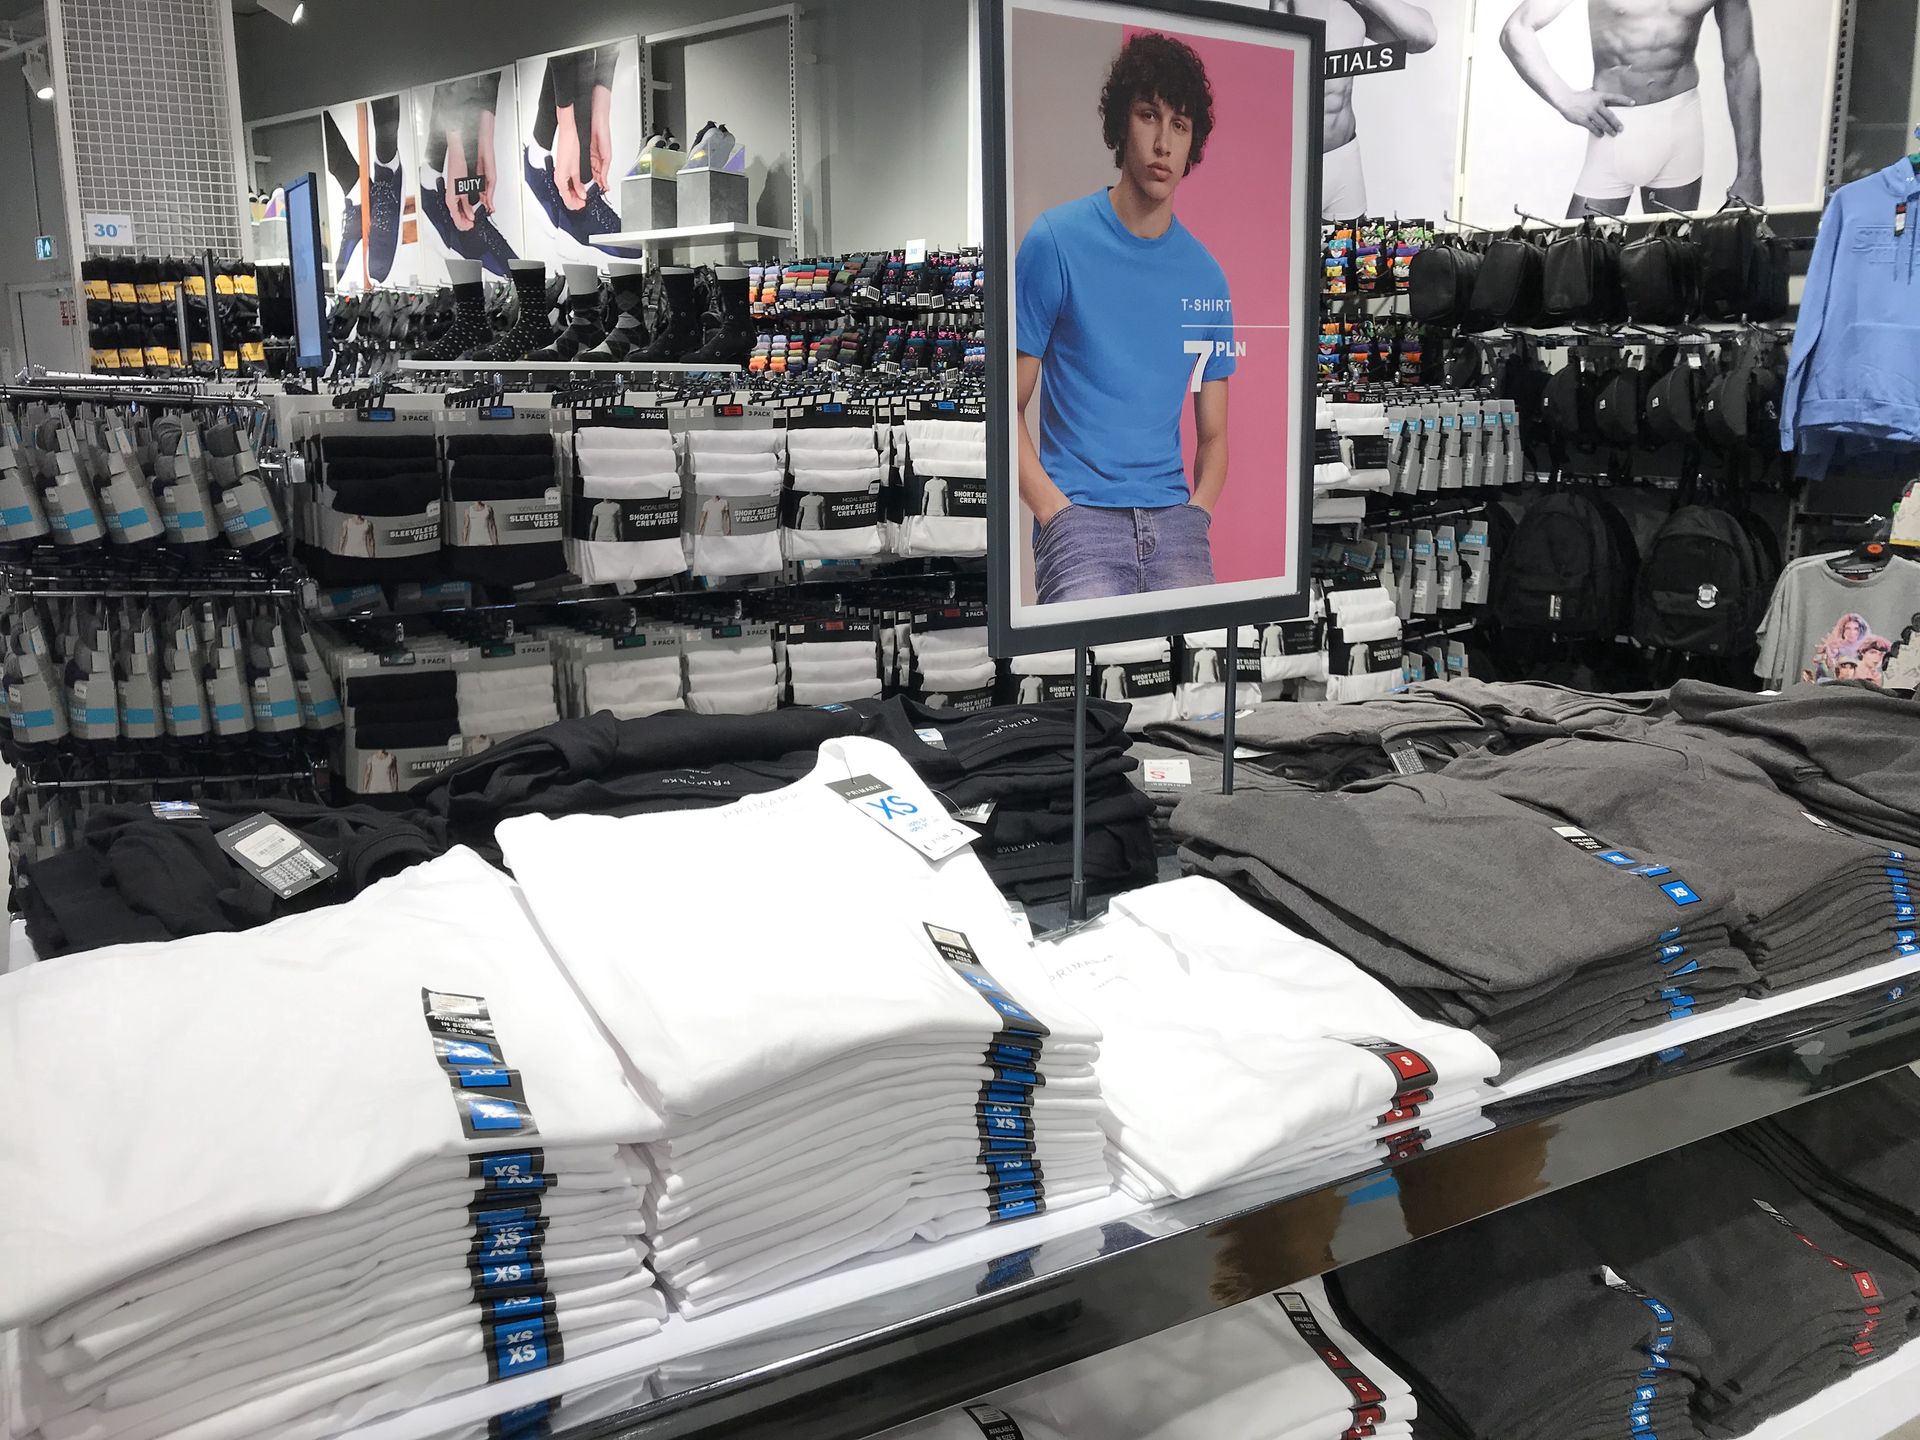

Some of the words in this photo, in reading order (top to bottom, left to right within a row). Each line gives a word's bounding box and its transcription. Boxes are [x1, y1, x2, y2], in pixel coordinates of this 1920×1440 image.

[1324, 47, 1393, 75] TIALS
[458, 178, 481, 192] BUTY
[94, 223, 118, 237] 30
[1181, 298, 1232, 312] T-SHIRT
[1183, 340, 1214, 393] 7
[1215, 341, 1247, 357] PLN
[646, 412, 665, 420] PACK
[953, 490, 974, 498] SHORT
[755, 506, 777, 514] SLEEVE
[831, 504, 854, 512] SHORT
[854, 501, 877, 509] SLEEVE
[509, 513, 558, 523] SLEEVELESS
[629, 513, 653, 521] SHORT
[654, 511, 678, 519] SLEEVE
[740, 514, 759, 522] NECK
[759, 512, 777, 520] VESTS
[533, 520, 559, 528] VESTS
[635, 519, 656, 527] CREW
[389, 525, 438, 538] SLEEVELESS
[413, 532, 438, 541] VESTS
[1131, 673, 1152, 682] SHORT
[1152, 669, 1170, 679] SLEEVE
[1137, 678, 1153, 686] CREW
[1154, 676, 1170, 684] VESTS
[1049, 685, 1068, 693] SHORT
[1054, 691, 1071, 699] CREW
[954, 701, 972, 709] SHORT
[973, 696, 993, 706] SLEEVE
[977, 702, 992, 710] VESTS
[1150, 769, 1166, 780] S
[845, 783, 881, 798] PRIMARK
[865, 795, 918, 820] XS
[1670, 887, 1689, 898] XS
[940, 945, 973, 959] AVAILABLE
[972, 976, 993, 988] XS
[998, 1001, 1020, 1014] XS
[1400, 1055, 1413, 1067] S
[995, 1118, 1017, 1130] XS
[494, 1164, 521, 1177] XS
[494, 1231, 522, 1248] XS
[494, 1264, 523, 1283] XS
[1862, 1279, 1869, 1289] S
[506, 1330, 534, 1345] XS
[508, 1344, 537, 1366] XS
[1327, 1351, 1338, 1361] S
[1356, 1382, 1368, 1392] S
[988, 1424, 1015, 1435] AVAILABLE
